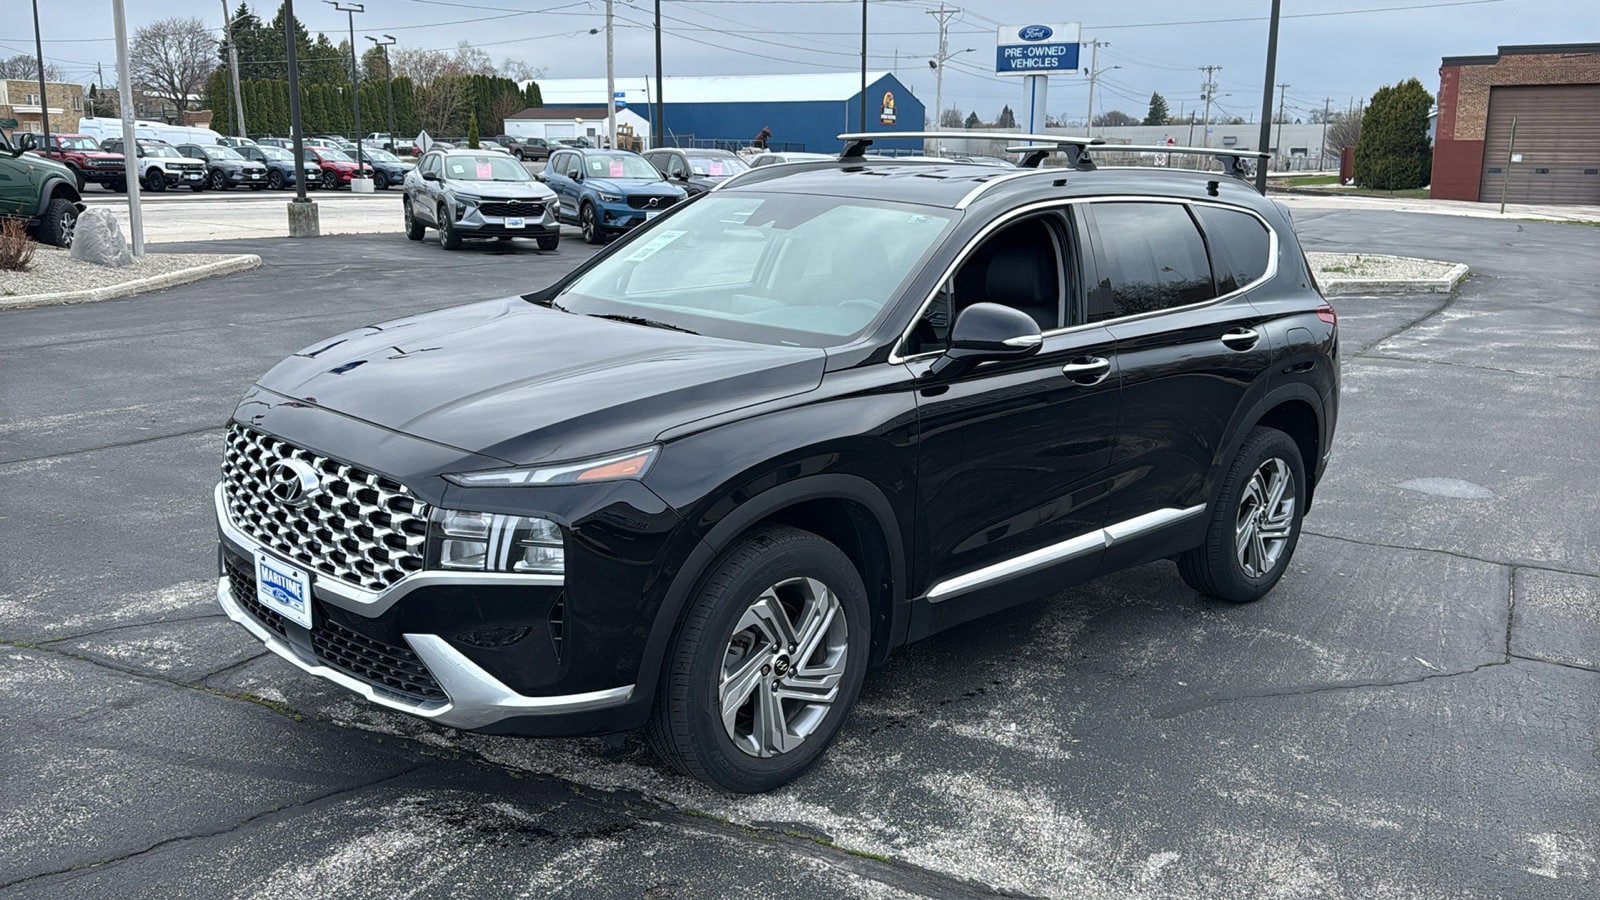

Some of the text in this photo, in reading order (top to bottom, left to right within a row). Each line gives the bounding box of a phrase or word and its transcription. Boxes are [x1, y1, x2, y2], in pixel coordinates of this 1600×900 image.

[1024, 28, 1045, 39] Ford
[1010, 57, 1059, 68] VEHICLES
[261, 565, 303, 602] MARITIME
